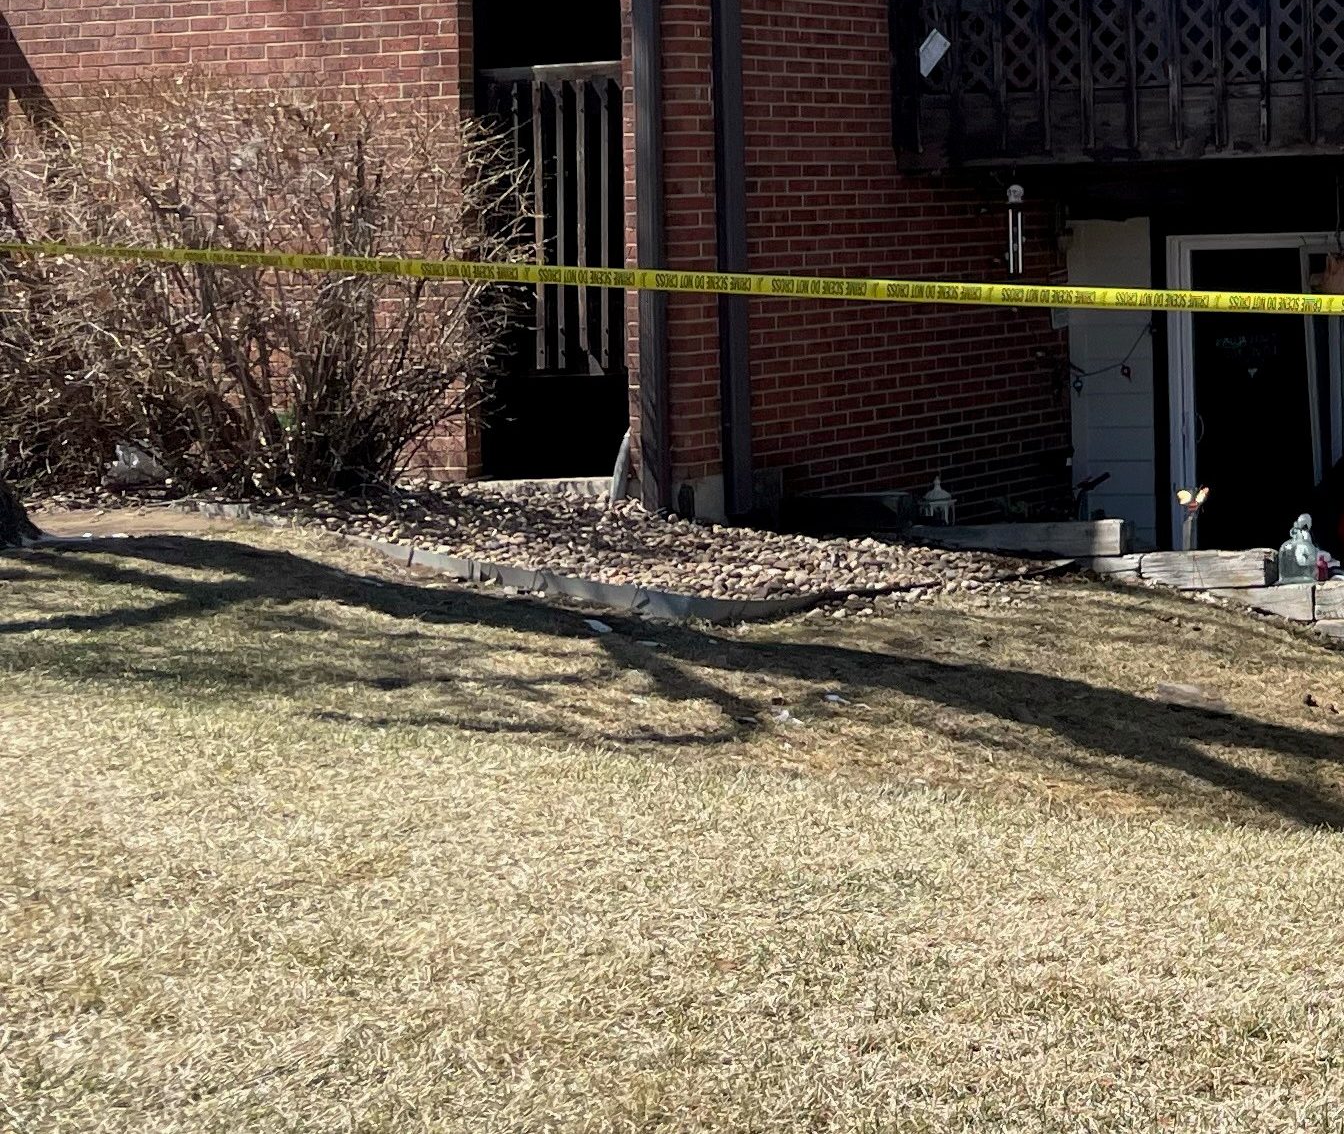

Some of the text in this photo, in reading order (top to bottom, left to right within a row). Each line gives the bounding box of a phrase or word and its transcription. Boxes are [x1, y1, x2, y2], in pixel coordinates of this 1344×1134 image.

[654, 273, 751, 291] CRIME SCENE DO NOT CROSS
[771, 279, 866, 296] CRIME SCENE DO NOT CROSS
[886, 284, 982, 300] CRIME SCENE DO NOT CROSS
[1001, 288, 1096, 303] CRIME SCENE DO NOT CROSS
[1114, 291, 1209, 308] CRIME SCENE DO NOT CROSS
[1228, 295, 1322, 310] CRIME SCENE DO NOT CROSS
